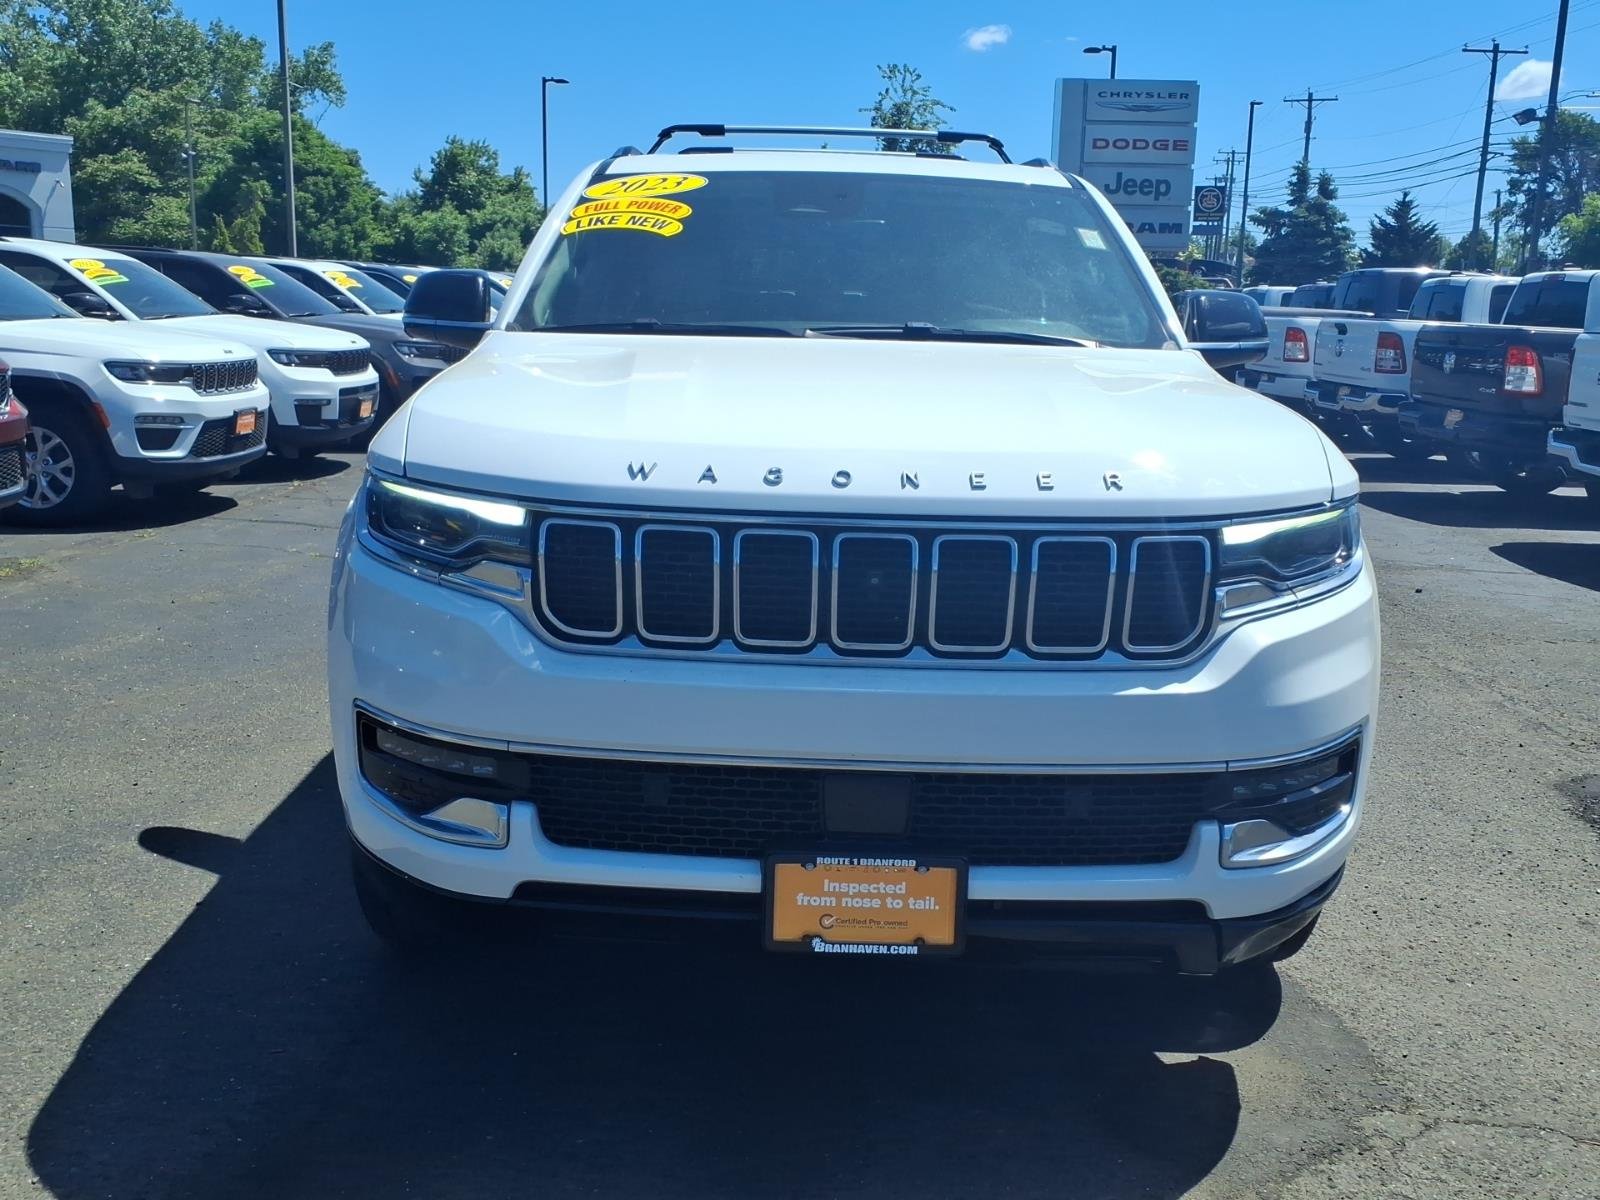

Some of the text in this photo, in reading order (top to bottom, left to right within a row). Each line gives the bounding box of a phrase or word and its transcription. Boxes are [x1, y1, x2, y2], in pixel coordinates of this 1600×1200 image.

[1097, 91, 1190, 100] CHRYSLER
[1092, 138, 1189, 151] DODGE
[602, 175, 689, 196] 2023
[1104, 172, 1171, 200] Jeep
[584, 200, 682, 214] FULL POWER
[575, 214, 673, 231] LIKE NEW
[627, 460, 1124, 492] WAGONEER
[816, 857, 851, 865] ROUTE
[859, 858, 917, 867] BRANFORD
[824, 879, 906, 895] Inspected
[796, 893, 939, 910] from nose to tail.
[836, 917, 867, 926] Certified
[814, 940, 918, 955] BRANHAVEN.COM
